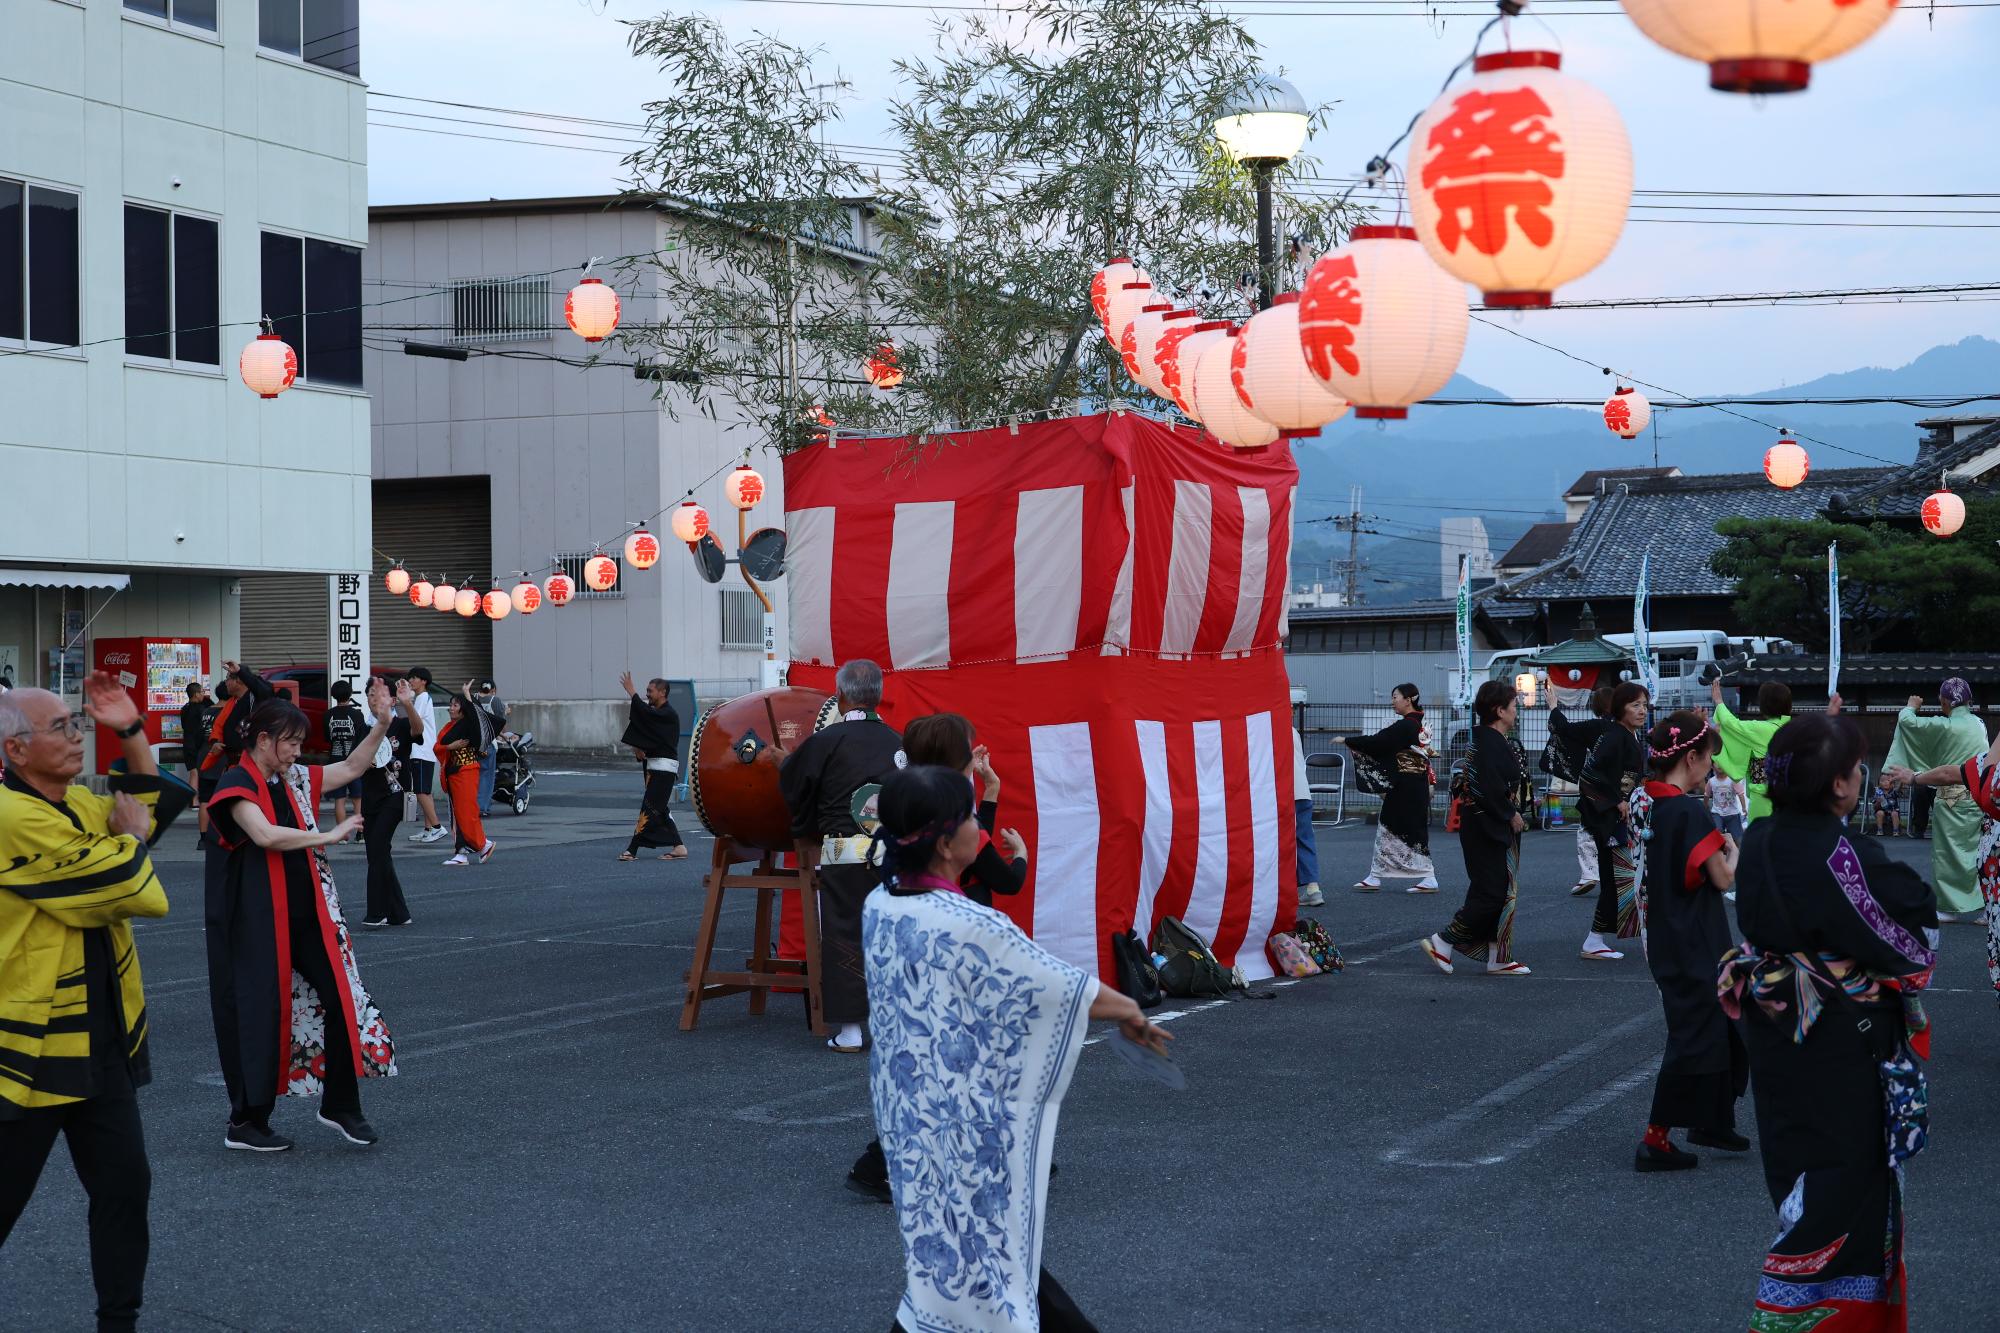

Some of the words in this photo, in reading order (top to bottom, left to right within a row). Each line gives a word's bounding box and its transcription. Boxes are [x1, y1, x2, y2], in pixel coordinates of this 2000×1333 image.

[1422, 86, 1565, 256] 祭
[1604, 399, 1631, 432] 祭
[739, 476, 763, 502] 祭
[693, 509, 709, 536] 祭
[1921, 498, 1941, 530] 祭
[635, 536, 657, 562] 祭
[598, 560, 616, 584] 祭
[524, 586, 541, 609] 祭
[548, 578, 569, 601] 祭
[339, 574, 362, 707] 野口町商工
